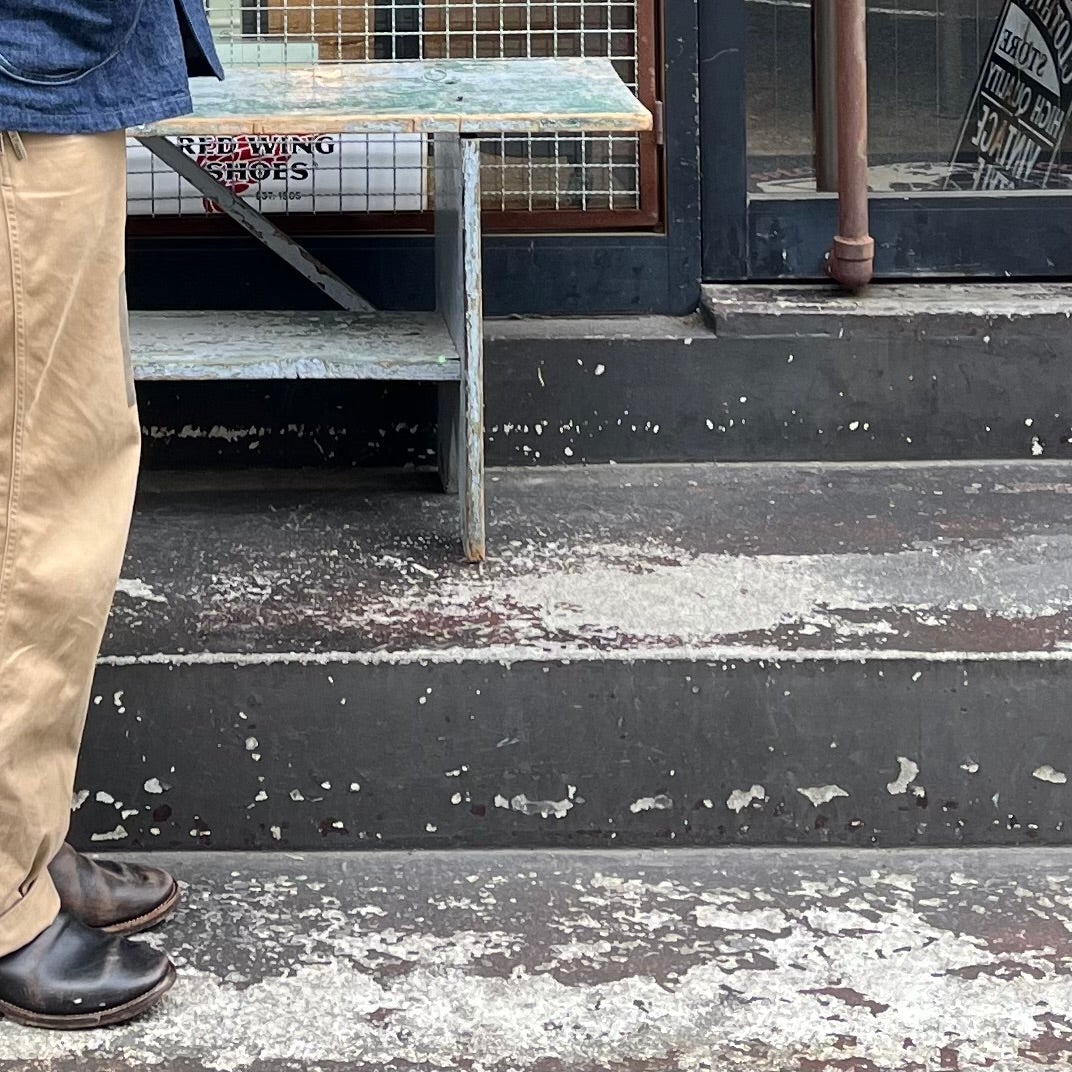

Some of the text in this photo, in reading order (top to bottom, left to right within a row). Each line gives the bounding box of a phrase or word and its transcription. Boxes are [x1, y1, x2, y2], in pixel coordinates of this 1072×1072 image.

[178, 136, 336, 155] RED WING
[206, 162, 310, 181] SHOES
